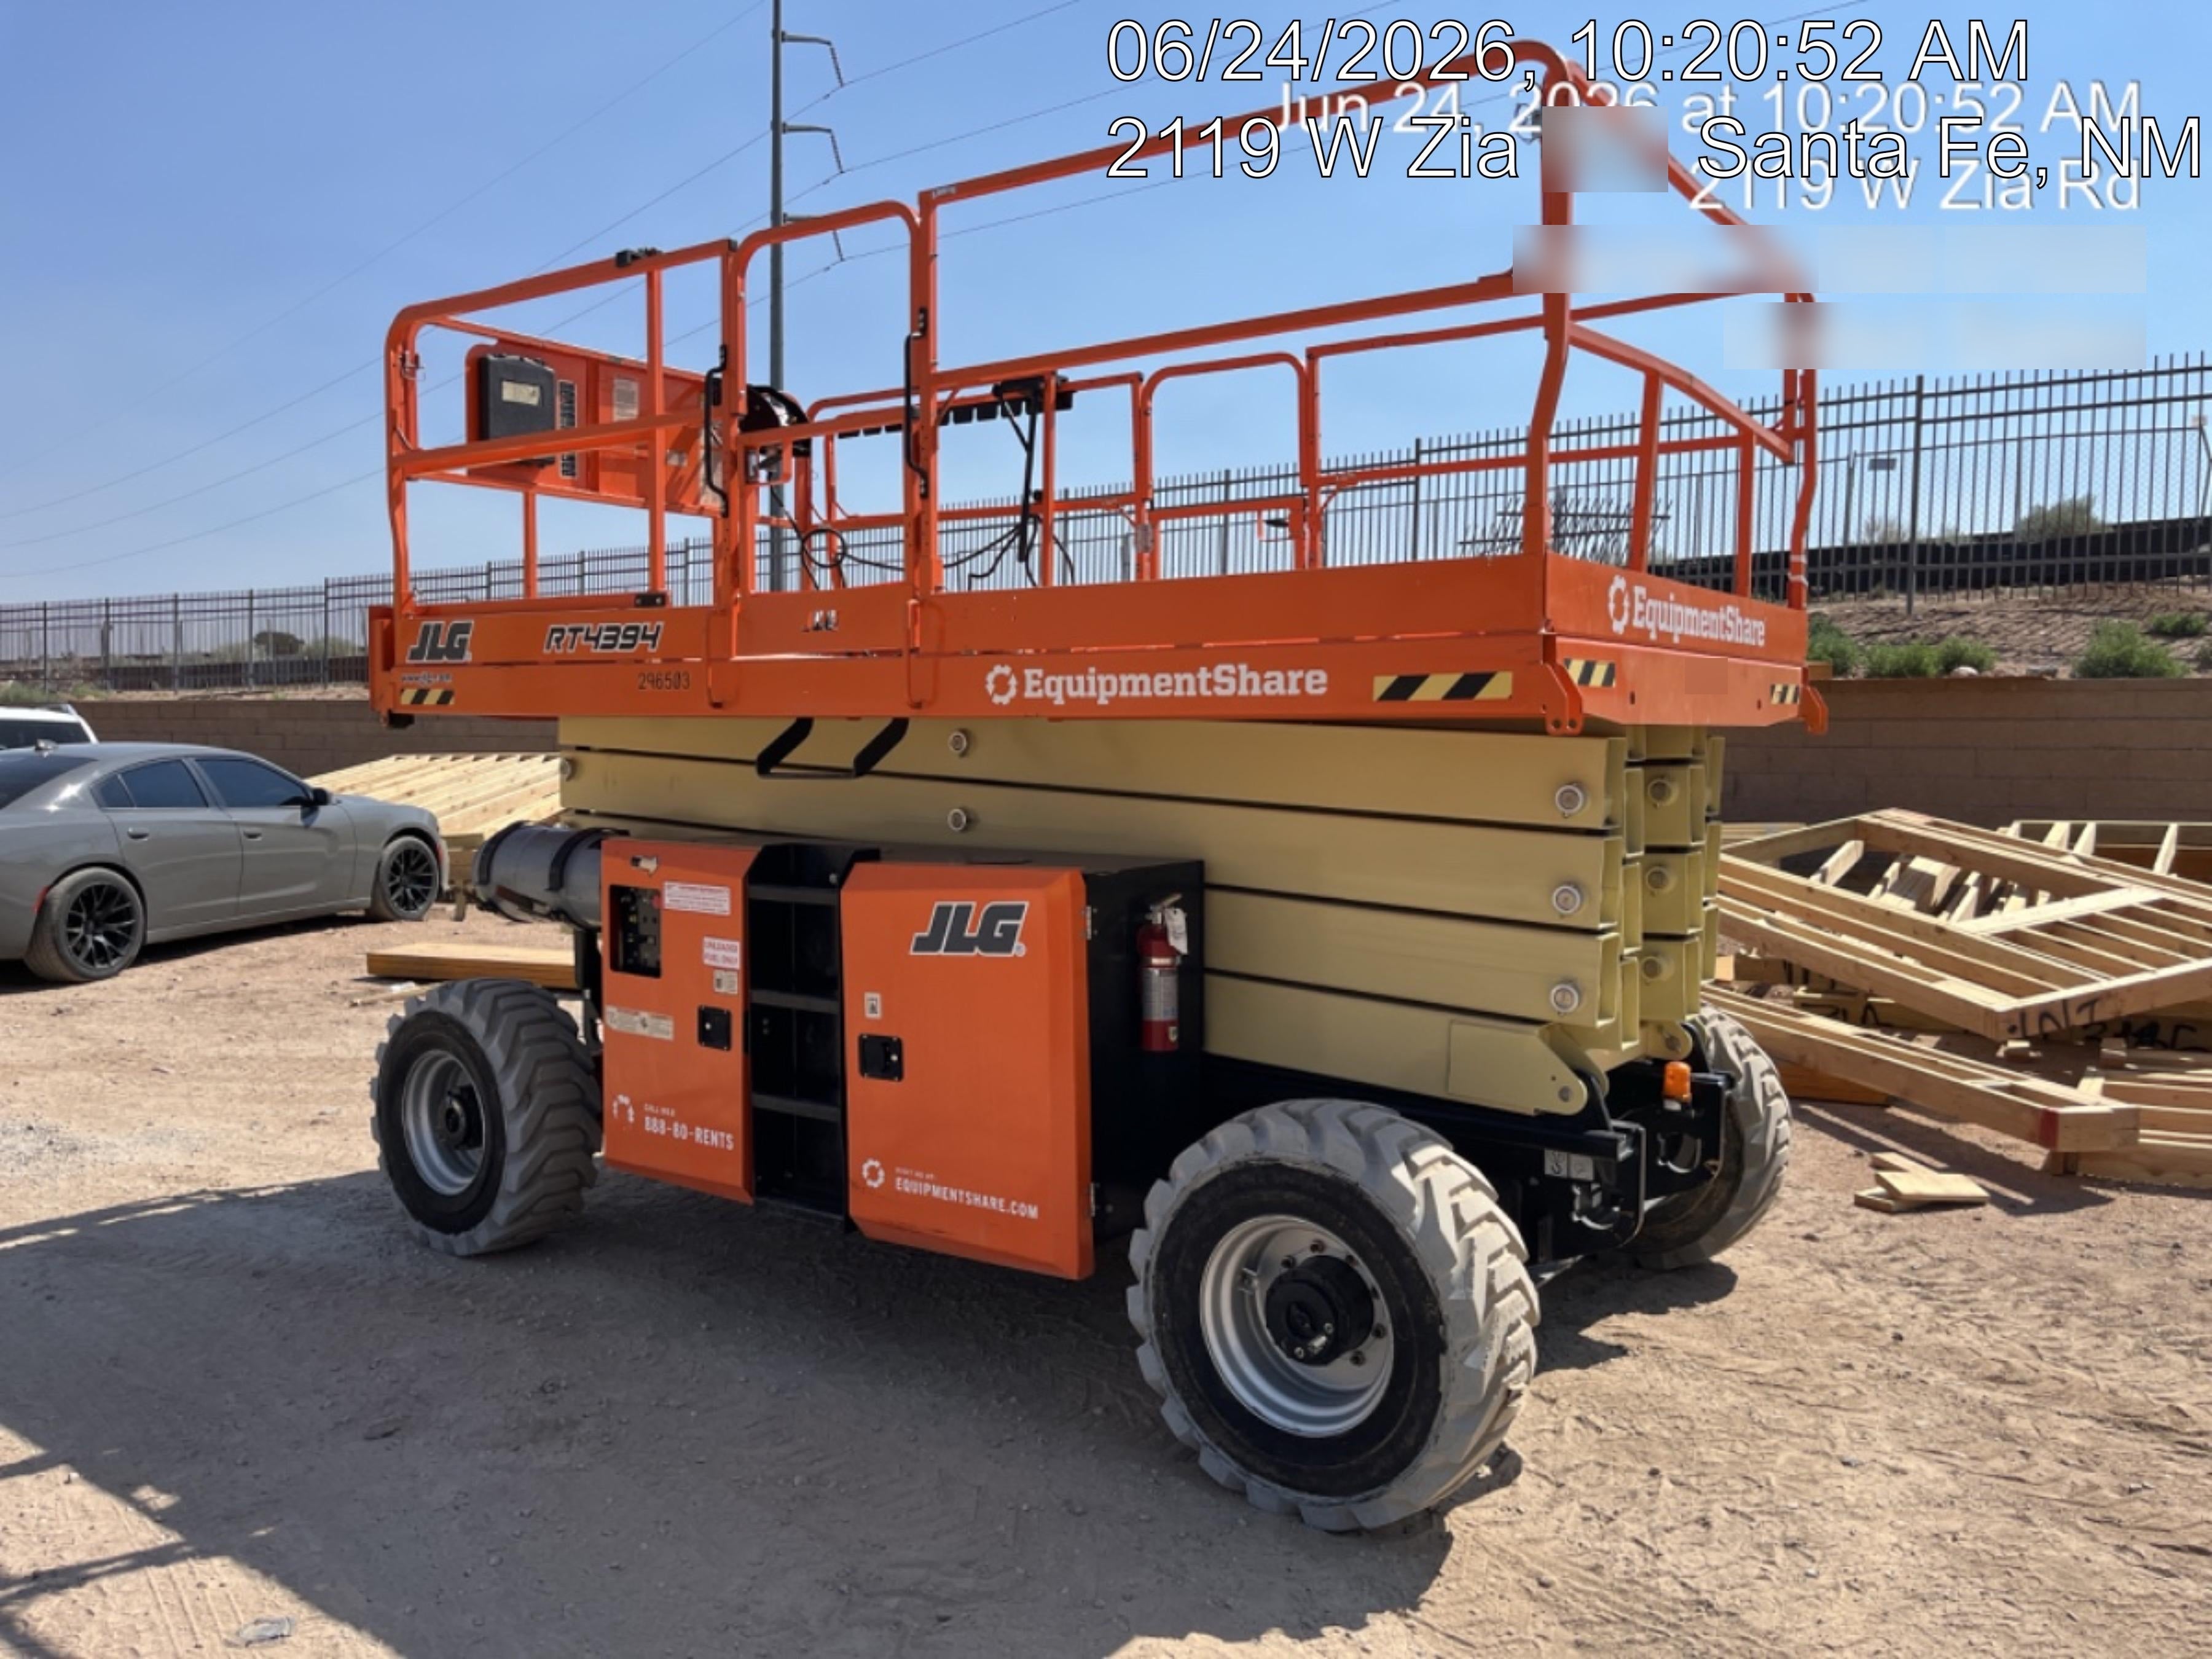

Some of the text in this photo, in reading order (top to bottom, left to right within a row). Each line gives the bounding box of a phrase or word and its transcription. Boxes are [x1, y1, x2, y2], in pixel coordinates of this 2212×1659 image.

[1632, 584, 1765, 647] EquipmentShare
[406, 619, 665, 664] JLG RT4394
[1023, 664, 1328, 705] EquipmentShare
[909, 900, 1030, 956] JLG
[895, 1176, 1039, 1220] EQUIPMENTSHARE.COM
